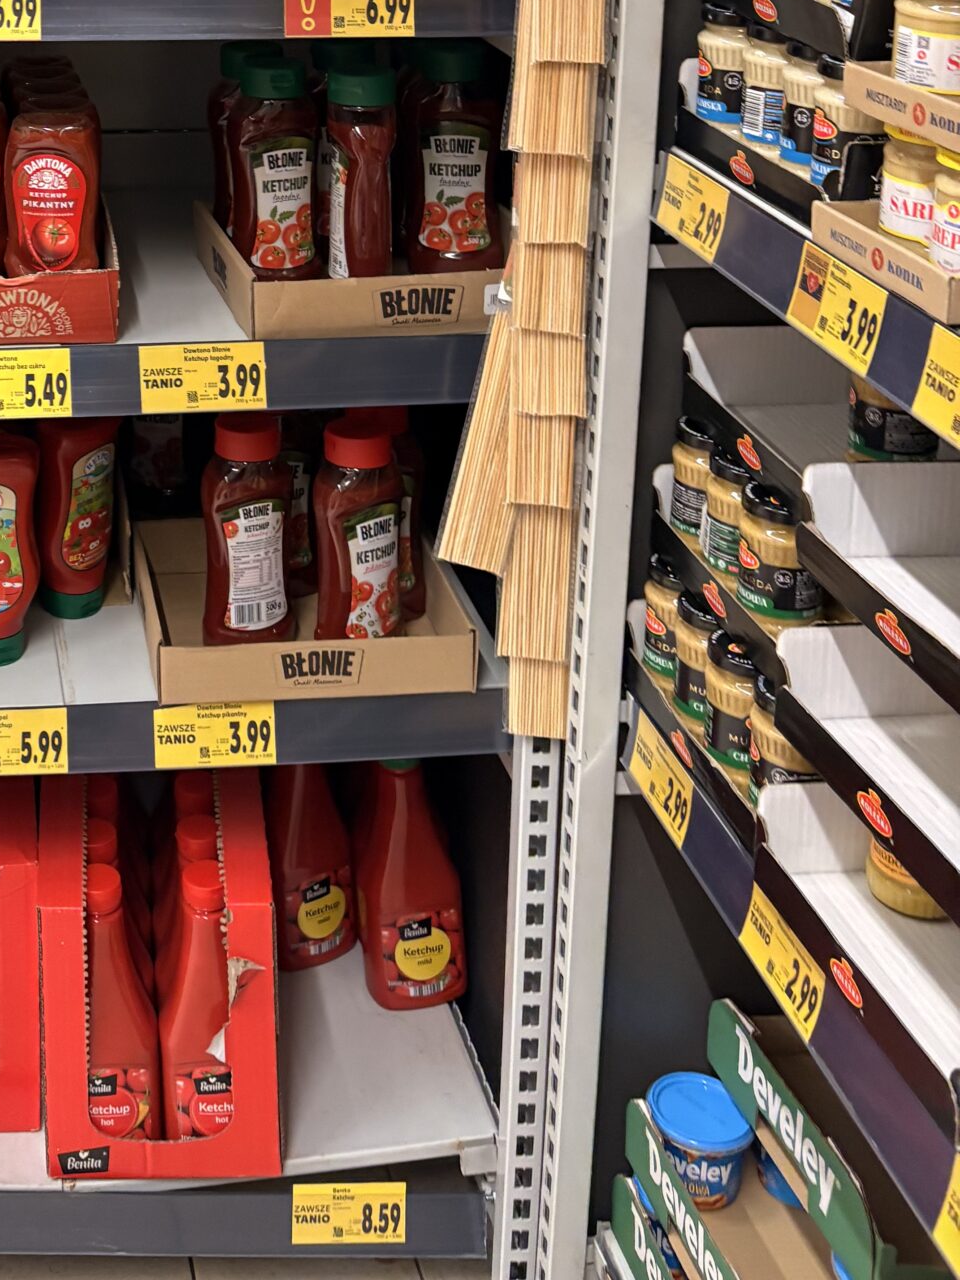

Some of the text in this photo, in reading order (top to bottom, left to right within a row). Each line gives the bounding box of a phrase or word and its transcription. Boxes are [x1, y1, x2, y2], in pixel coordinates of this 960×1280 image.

[24, 158, 73, 178] DAWTONA
[267, 151, 304, 170] BŁONIE
[429, 163, 482, 178] KETCHUP
[22, 199, 74, 209] PIKANTNY
[692, 201, 723, 250] 2.99
[380, 287, 456, 319] BŁONIE
[841, 297, 878, 357] 3.99
[142, 366, 183, 377] ZAWSZE
[217, 363, 261, 399] 3.99
[25, 371, 68, 408] 5.49
[143, 378, 183, 389] TANIO
[280, 650, 356, 679] BŁONIE
[157, 723, 196, 733] ZAWSZE
[228, 719, 271, 755] 3.99
[20, 729, 63, 765] 5.99
[158, 734, 196, 745] TANIO
[403, 925, 428, 939] Benita
[403, 942, 444, 958] Ketchup
[785, 959, 818, 1022] 2.99
[100, 1118, 115, 1127] hot
[735, 1023, 836, 1216] Develey
[66, 1156, 103, 1171] Benita
[294, 1205, 331, 1213] ZAWSZE
[361, 1202, 401, 1234] 8.59
[294, 1214, 331, 1224] TANIO
